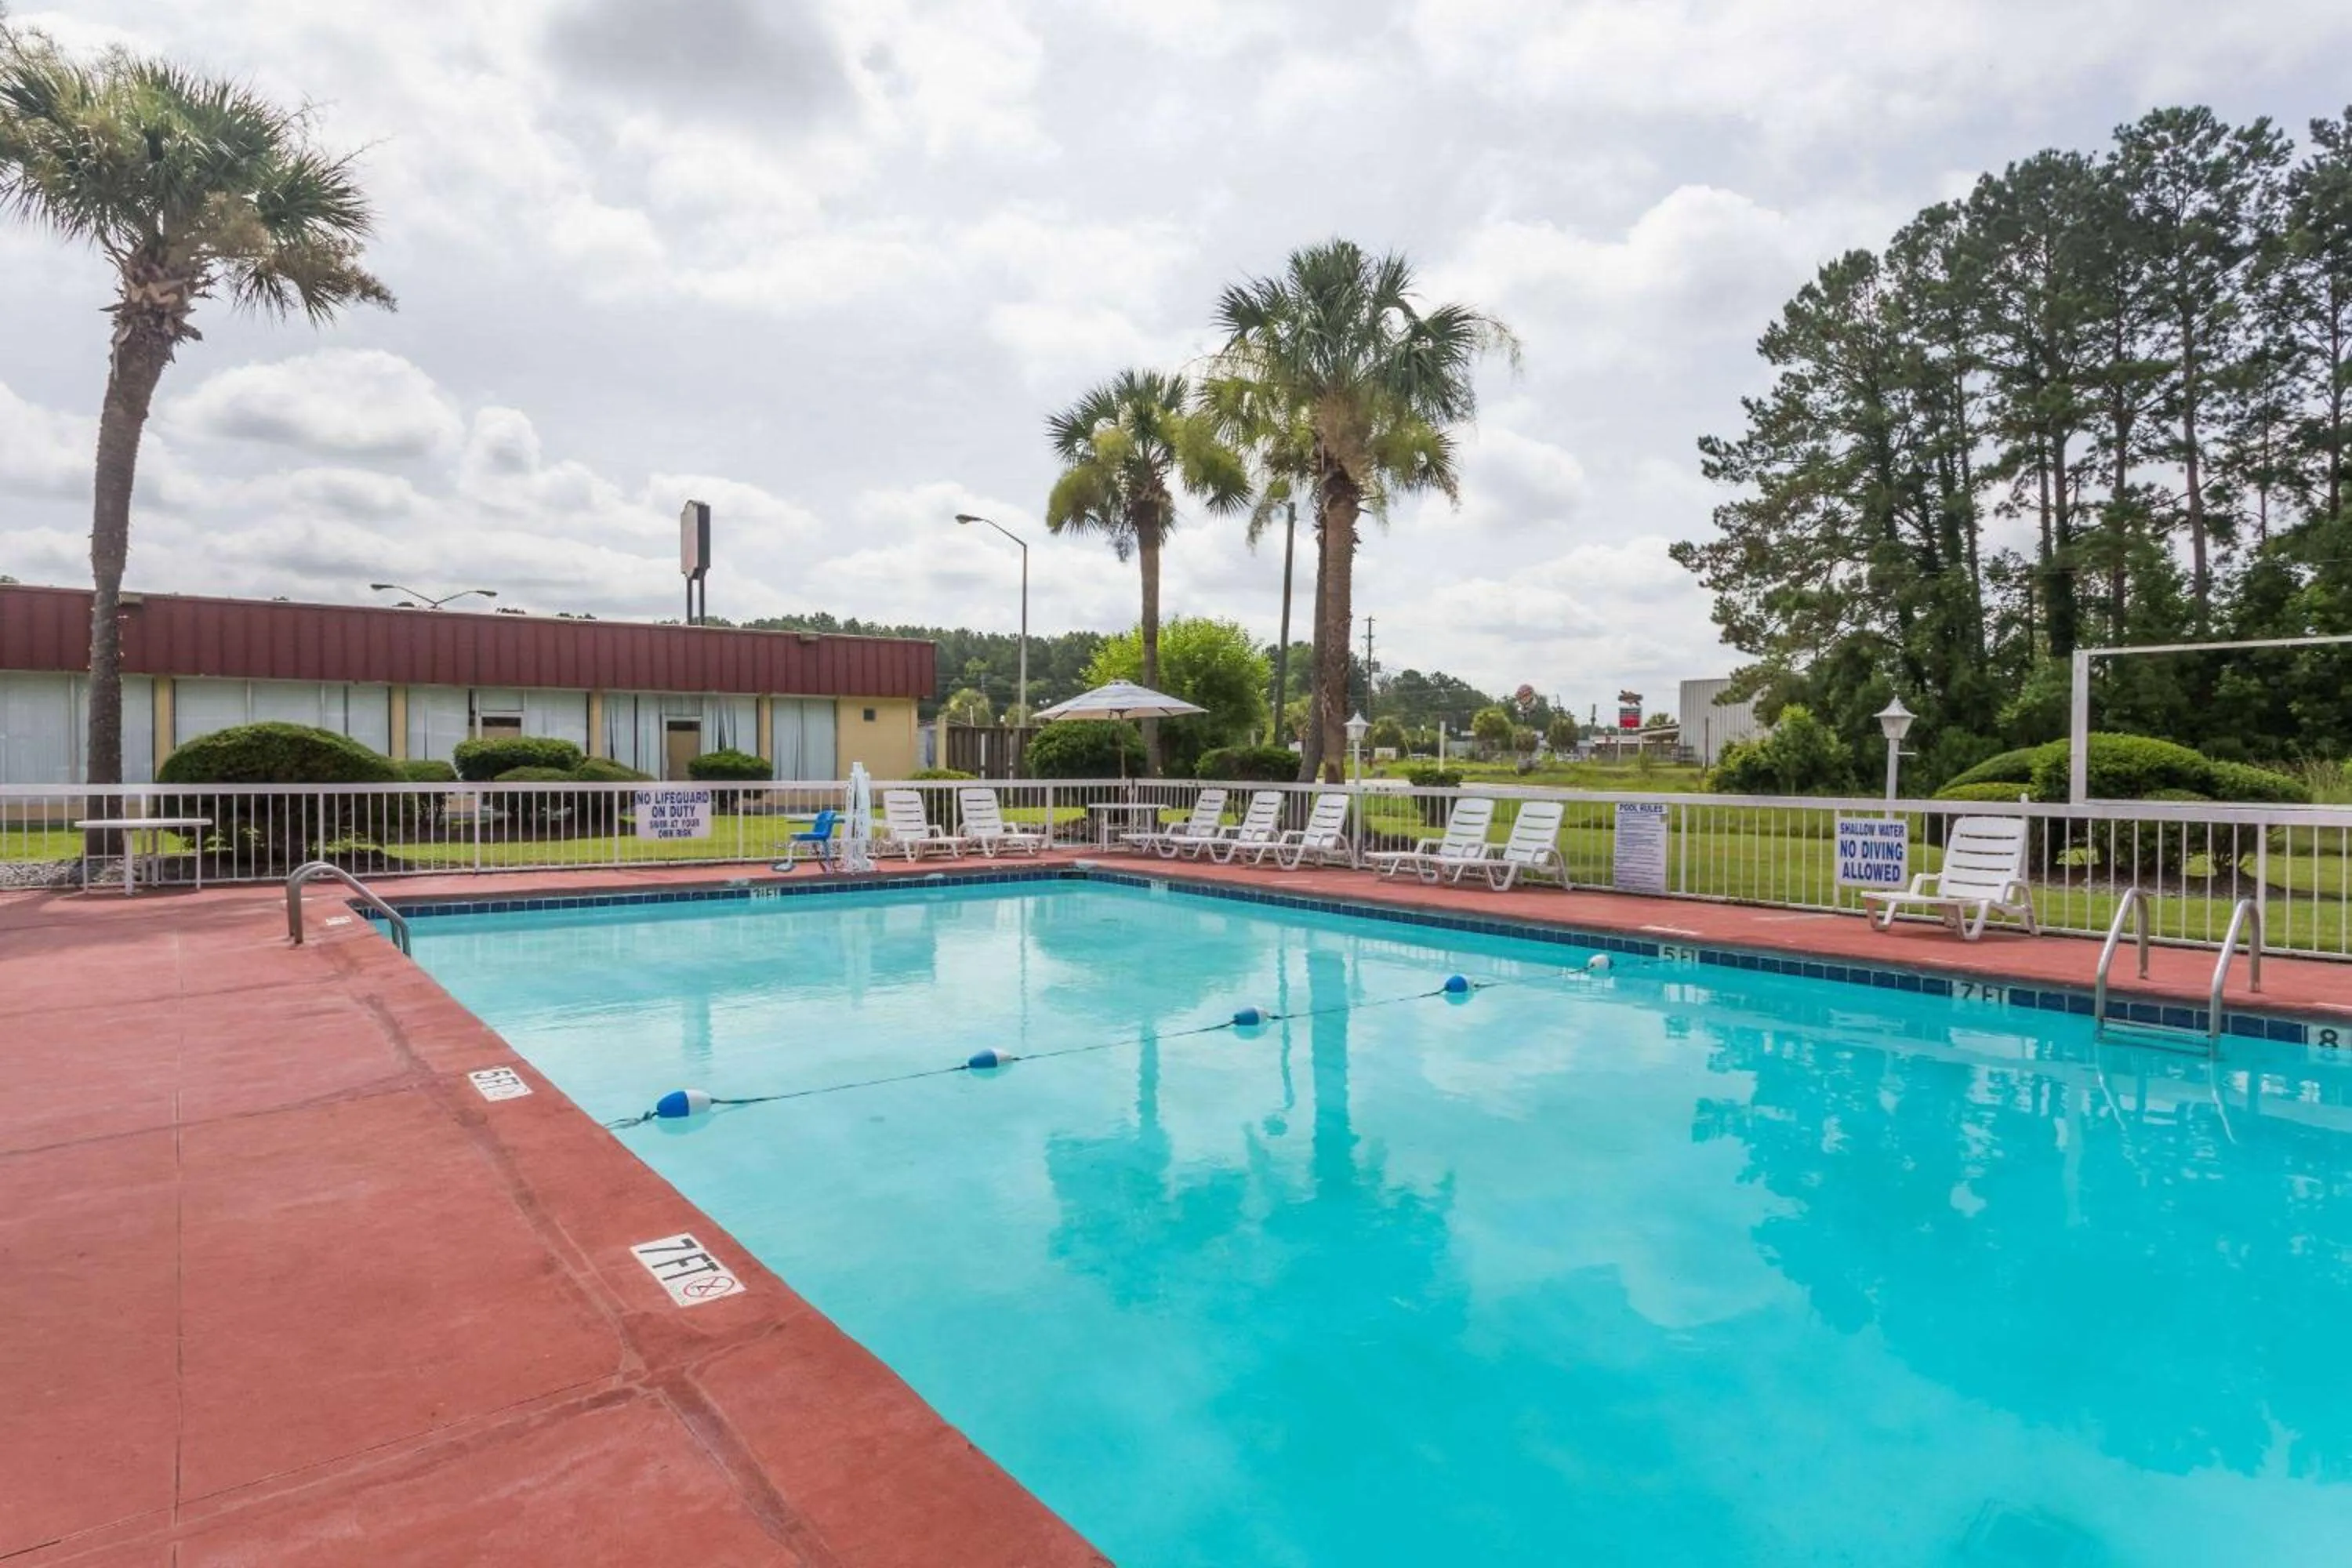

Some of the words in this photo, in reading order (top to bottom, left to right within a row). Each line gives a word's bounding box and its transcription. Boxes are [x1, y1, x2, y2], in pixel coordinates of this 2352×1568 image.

[636, 792, 651, 804] NO
[655, 791, 709, 804] LIFEGUARD
[652, 806, 666, 817] ON
[670, 805, 695, 817] DUTY
[1640, 804, 1663, 813] RULES
[1840, 822, 1876, 836] SHALLOW
[1878, 824, 1904, 837] WATER
[1840, 840, 1857, 858] NO
[1861, 840, 1904, 861] DIVING
[1842, 862, 1900, 882] ALLOWED
